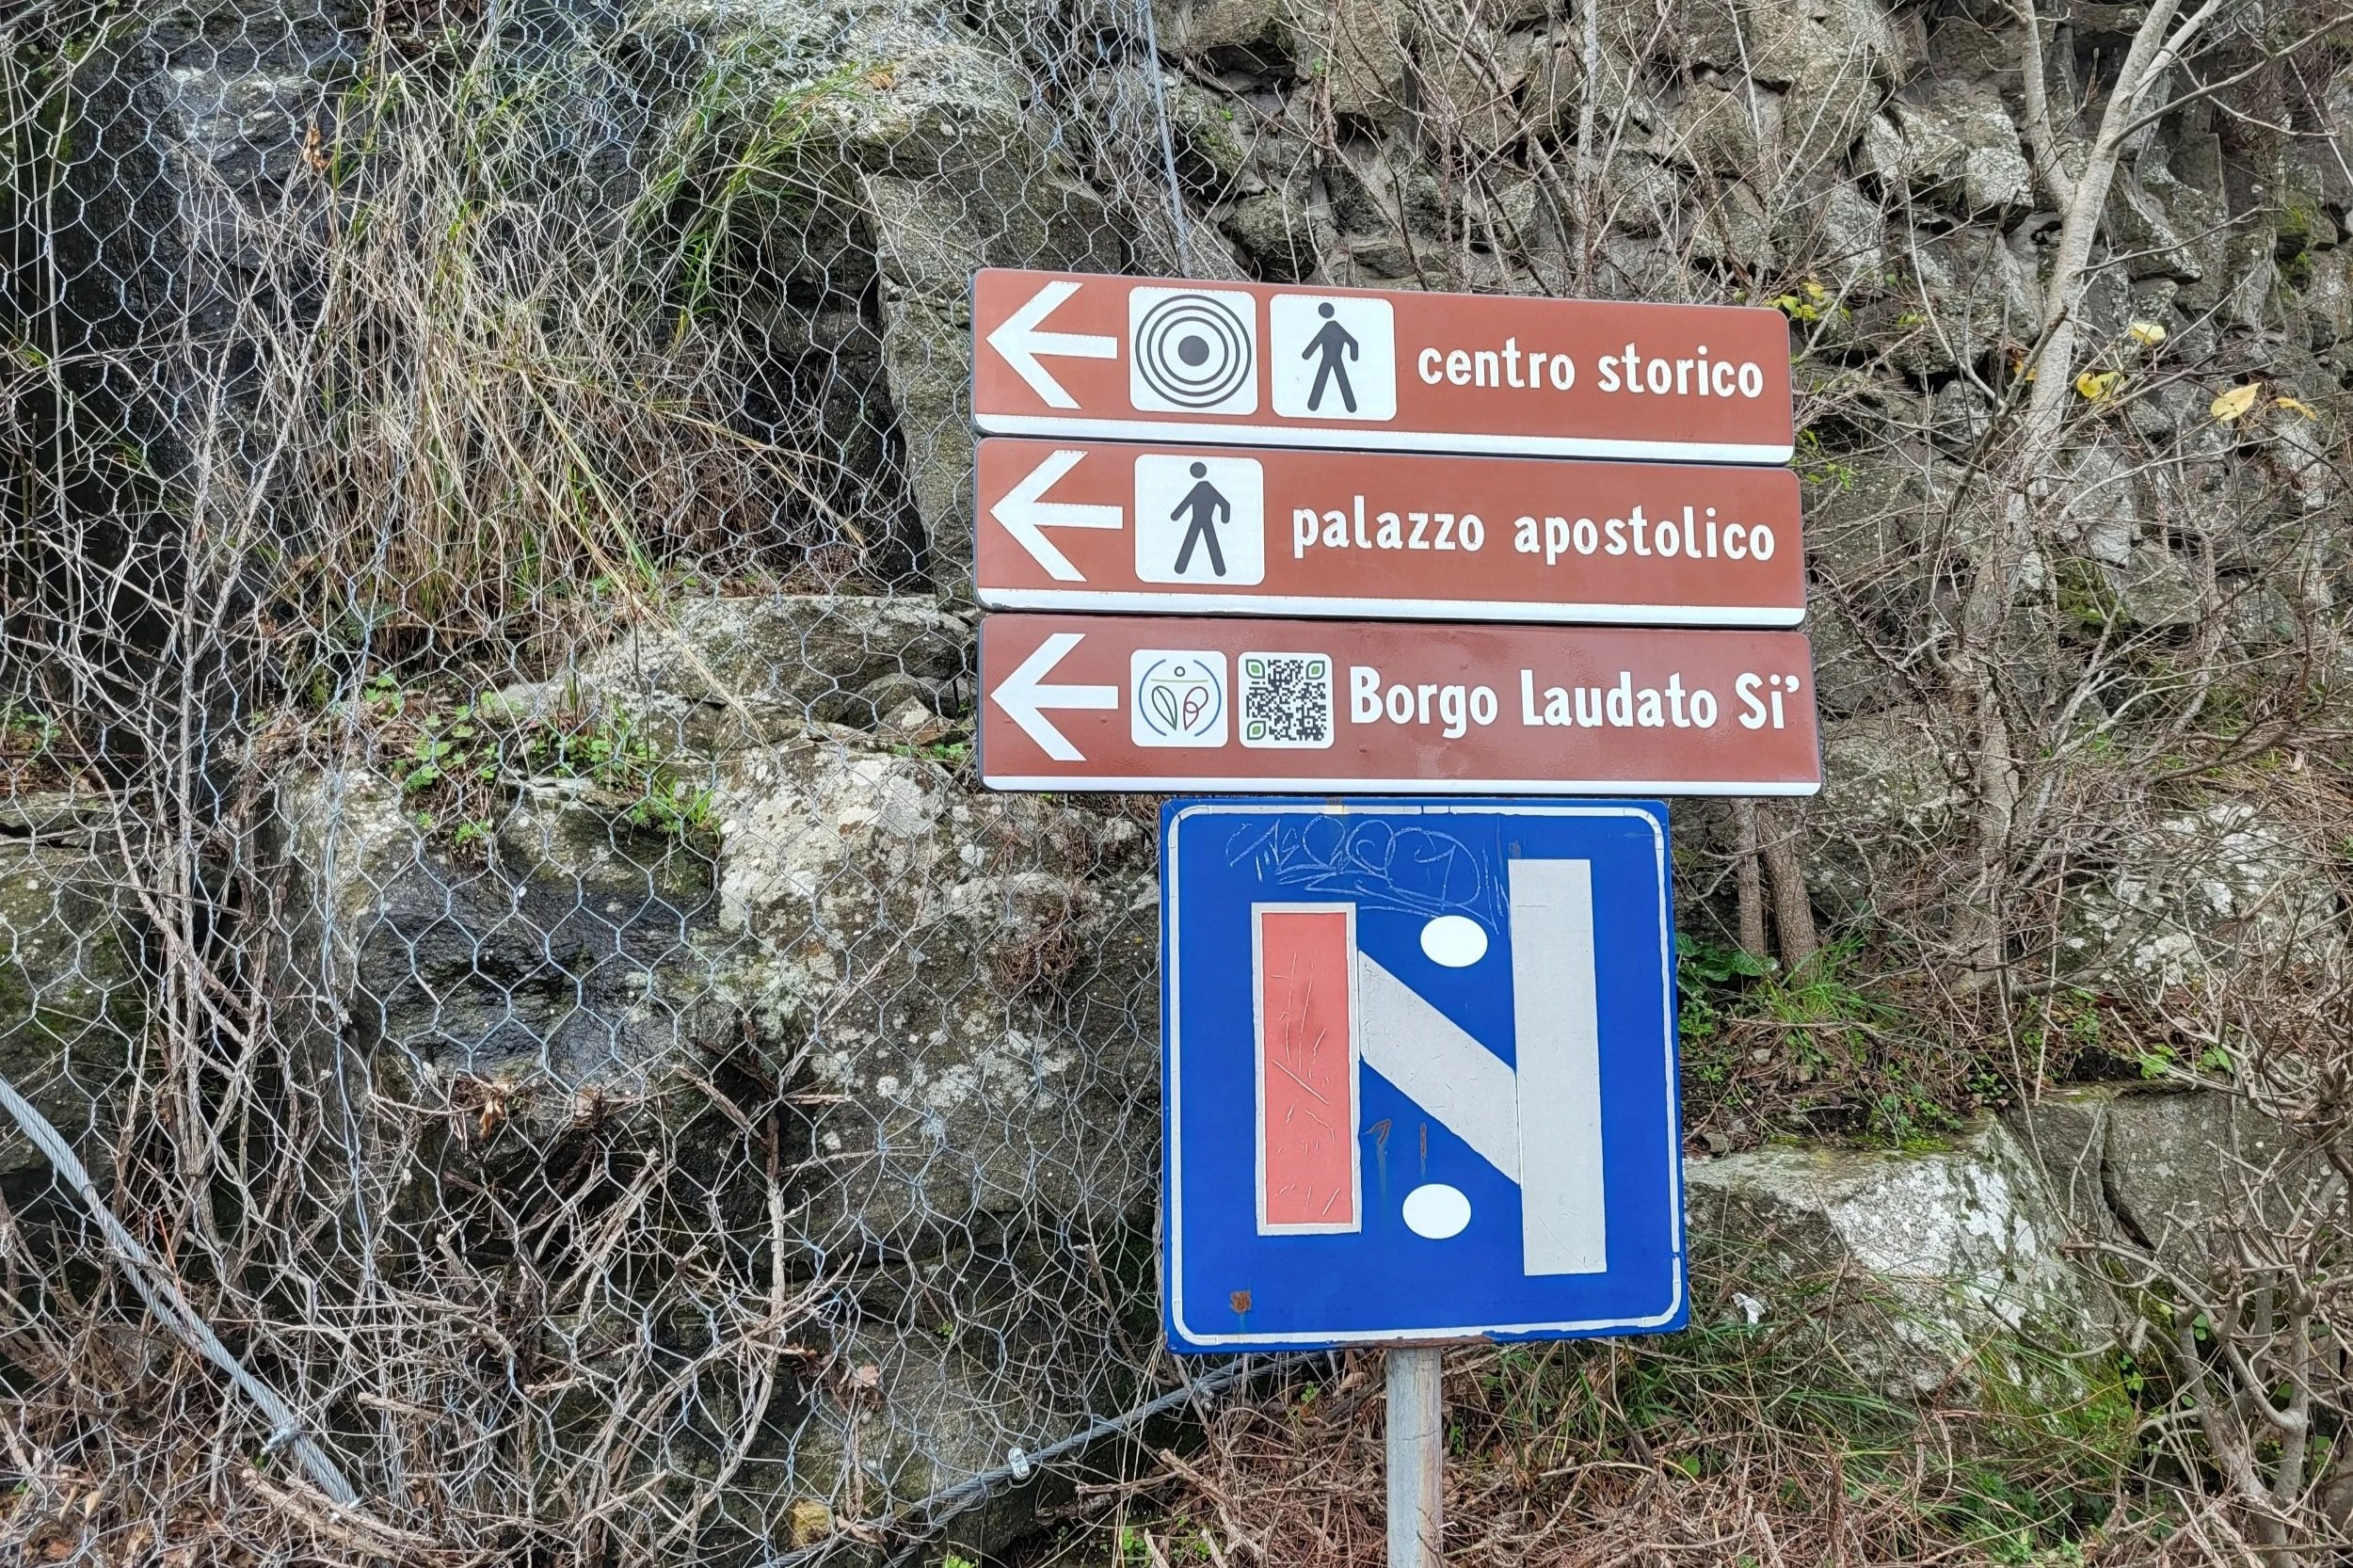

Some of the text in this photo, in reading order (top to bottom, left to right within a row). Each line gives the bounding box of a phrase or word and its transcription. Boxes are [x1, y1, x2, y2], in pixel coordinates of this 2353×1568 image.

[1417, 337, 1765, 399] centro storico
[1291, 493, 1777, 567] palazzo apostolico
[1350, 664, 1801, 738] Borgo Laudato Si'
